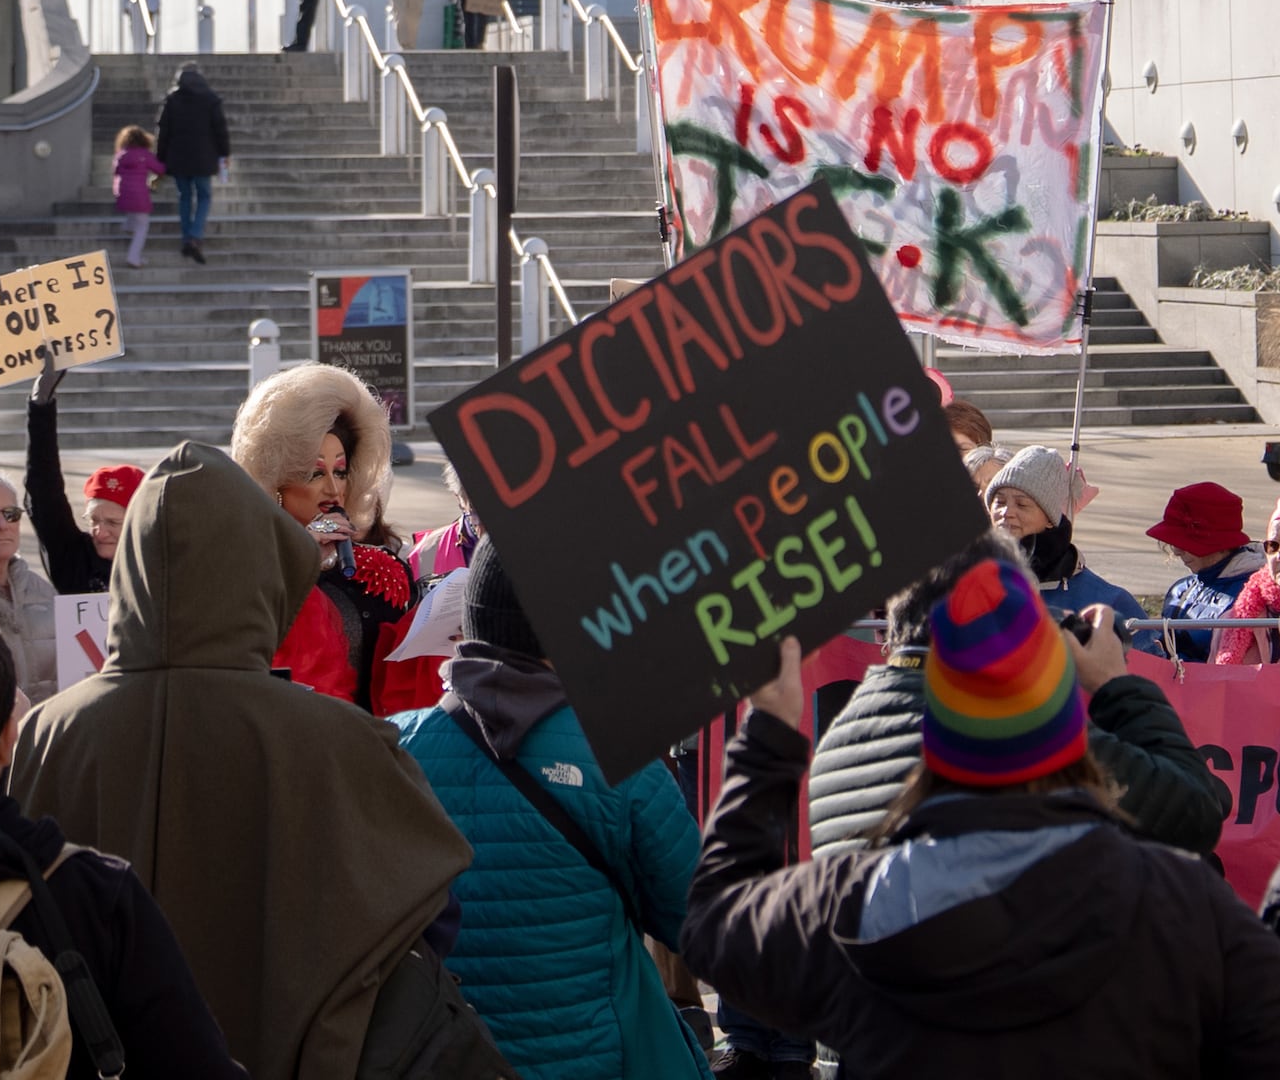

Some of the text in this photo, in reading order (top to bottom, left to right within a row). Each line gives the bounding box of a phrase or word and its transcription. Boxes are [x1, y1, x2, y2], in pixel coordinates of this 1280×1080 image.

[734, 83, 995, 185] IS NO
[5, 303, 60, 336] OUR
[322, 339, 392, 355] THANK YOU
[458, 192, 862, 508] DICTATORS
[622, 404, 779, 526] FALL
[581, 529, 730, 651] when
[695, 496, 883, 665] RISE!
[541, 766, 570, 778] NORTH
[548, 774, 570, 785] FACE
[555, 761, 570, 771] THE
